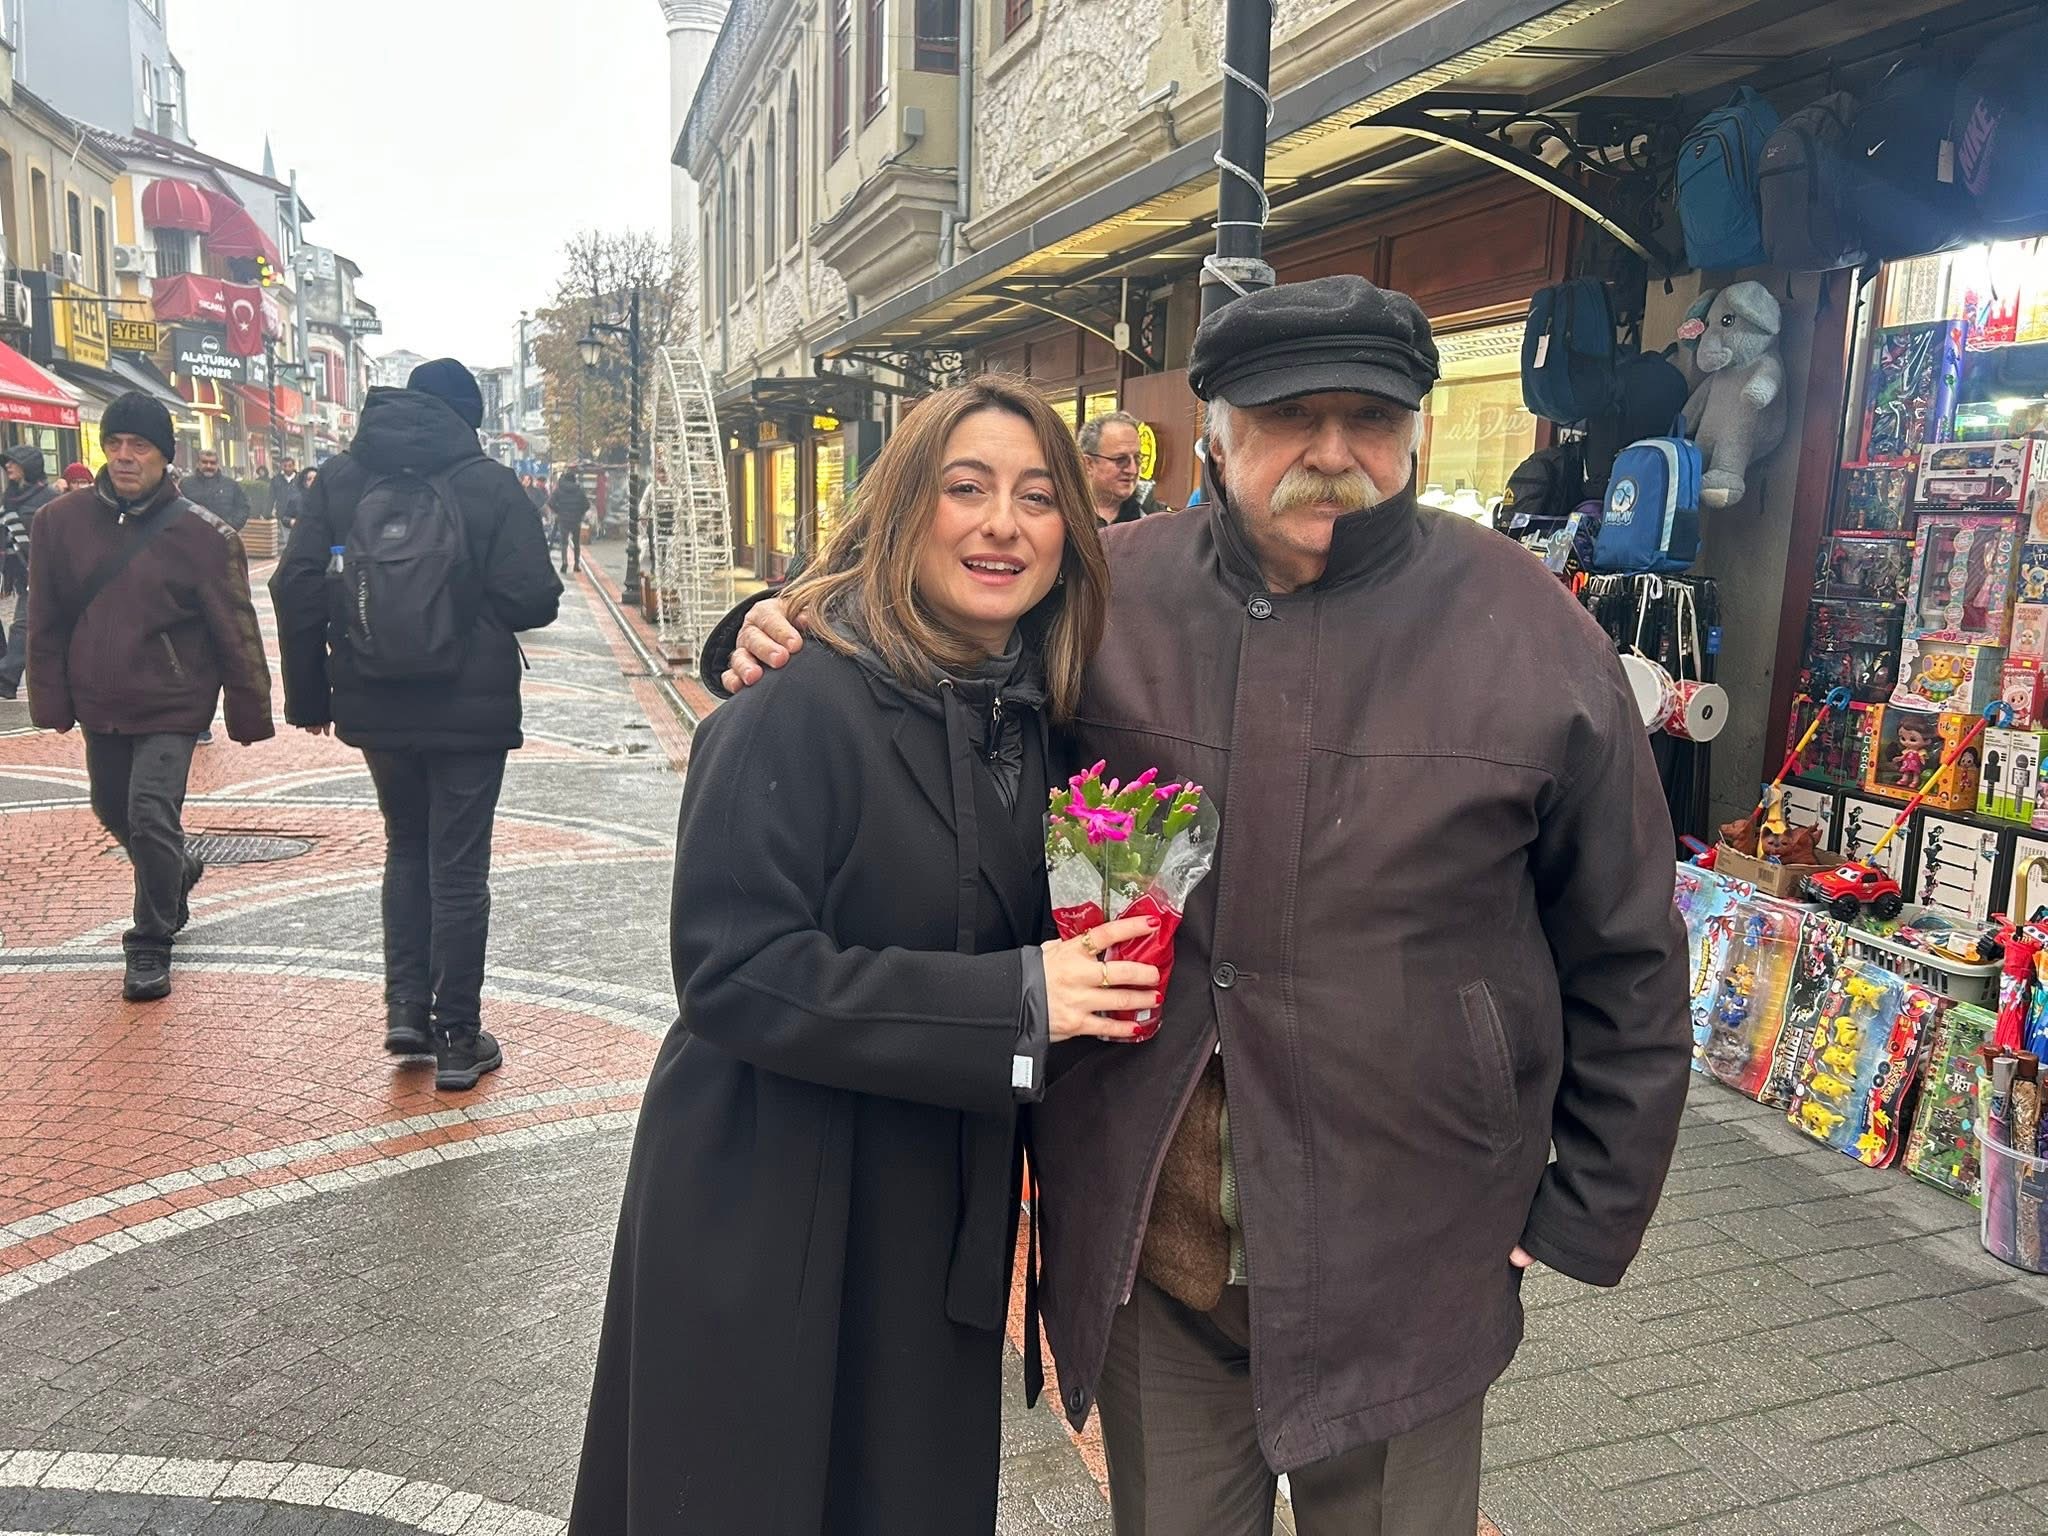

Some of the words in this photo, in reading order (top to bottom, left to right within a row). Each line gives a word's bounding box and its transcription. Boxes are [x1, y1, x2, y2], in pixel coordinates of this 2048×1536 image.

[111, 321, 154, 341] EYFEL
[181, 351, 241, 369] ALATURKA
[191, 365, 232, 380] DÖNER
